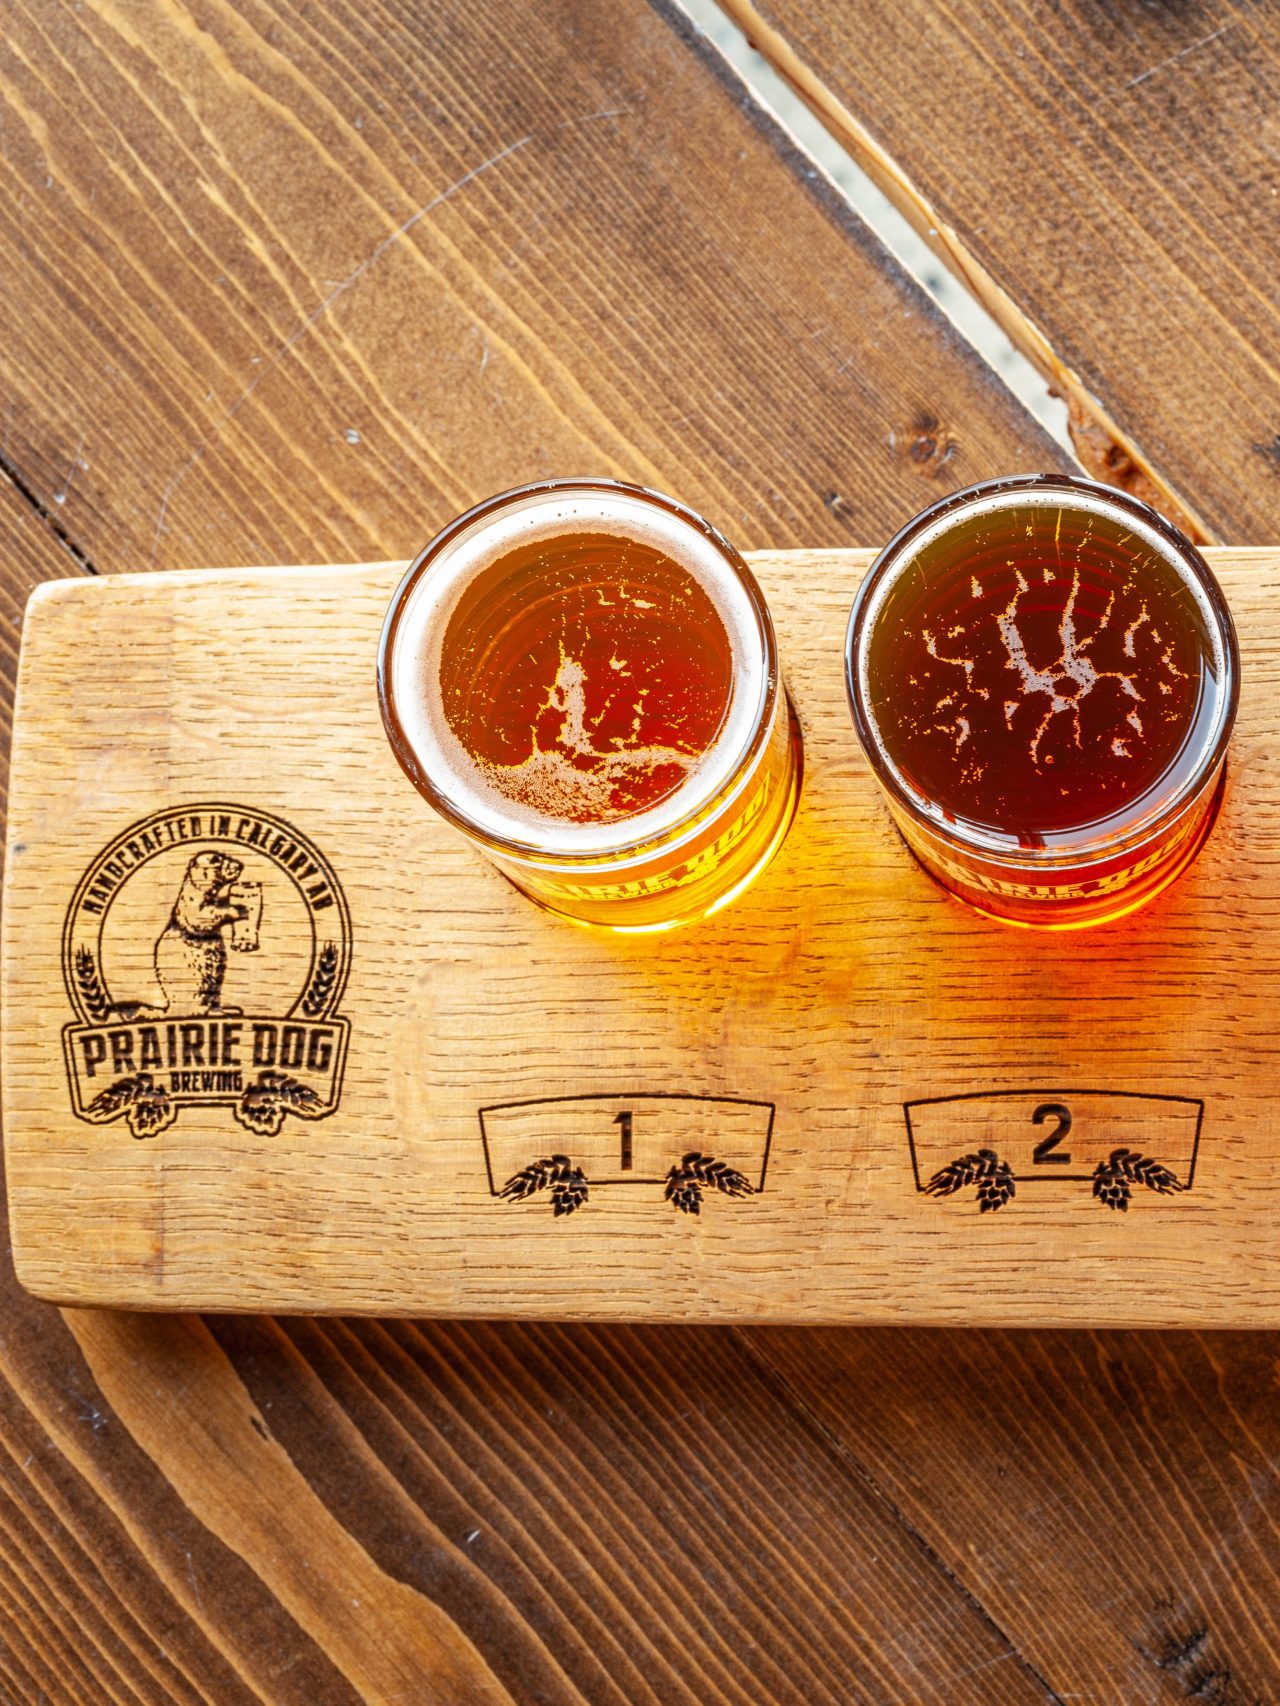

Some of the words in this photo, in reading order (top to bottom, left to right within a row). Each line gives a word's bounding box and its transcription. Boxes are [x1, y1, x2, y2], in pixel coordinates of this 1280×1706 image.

[82, 815, 201, 915] HANDCRAFTED
[209, 815, 231, 837] IN
[237, 818, 318, 886] CALGARY
[305, 885, 334, 912] AB
[79, 1022, 242, 1078] PRAIRIE
[252, 1022, 334, 1072] DOG
[169, 1070, 243, 1093] BREWING
[613, 1111, 632, 1170] 1
[1028, 1103, 1071, 1165] 2
